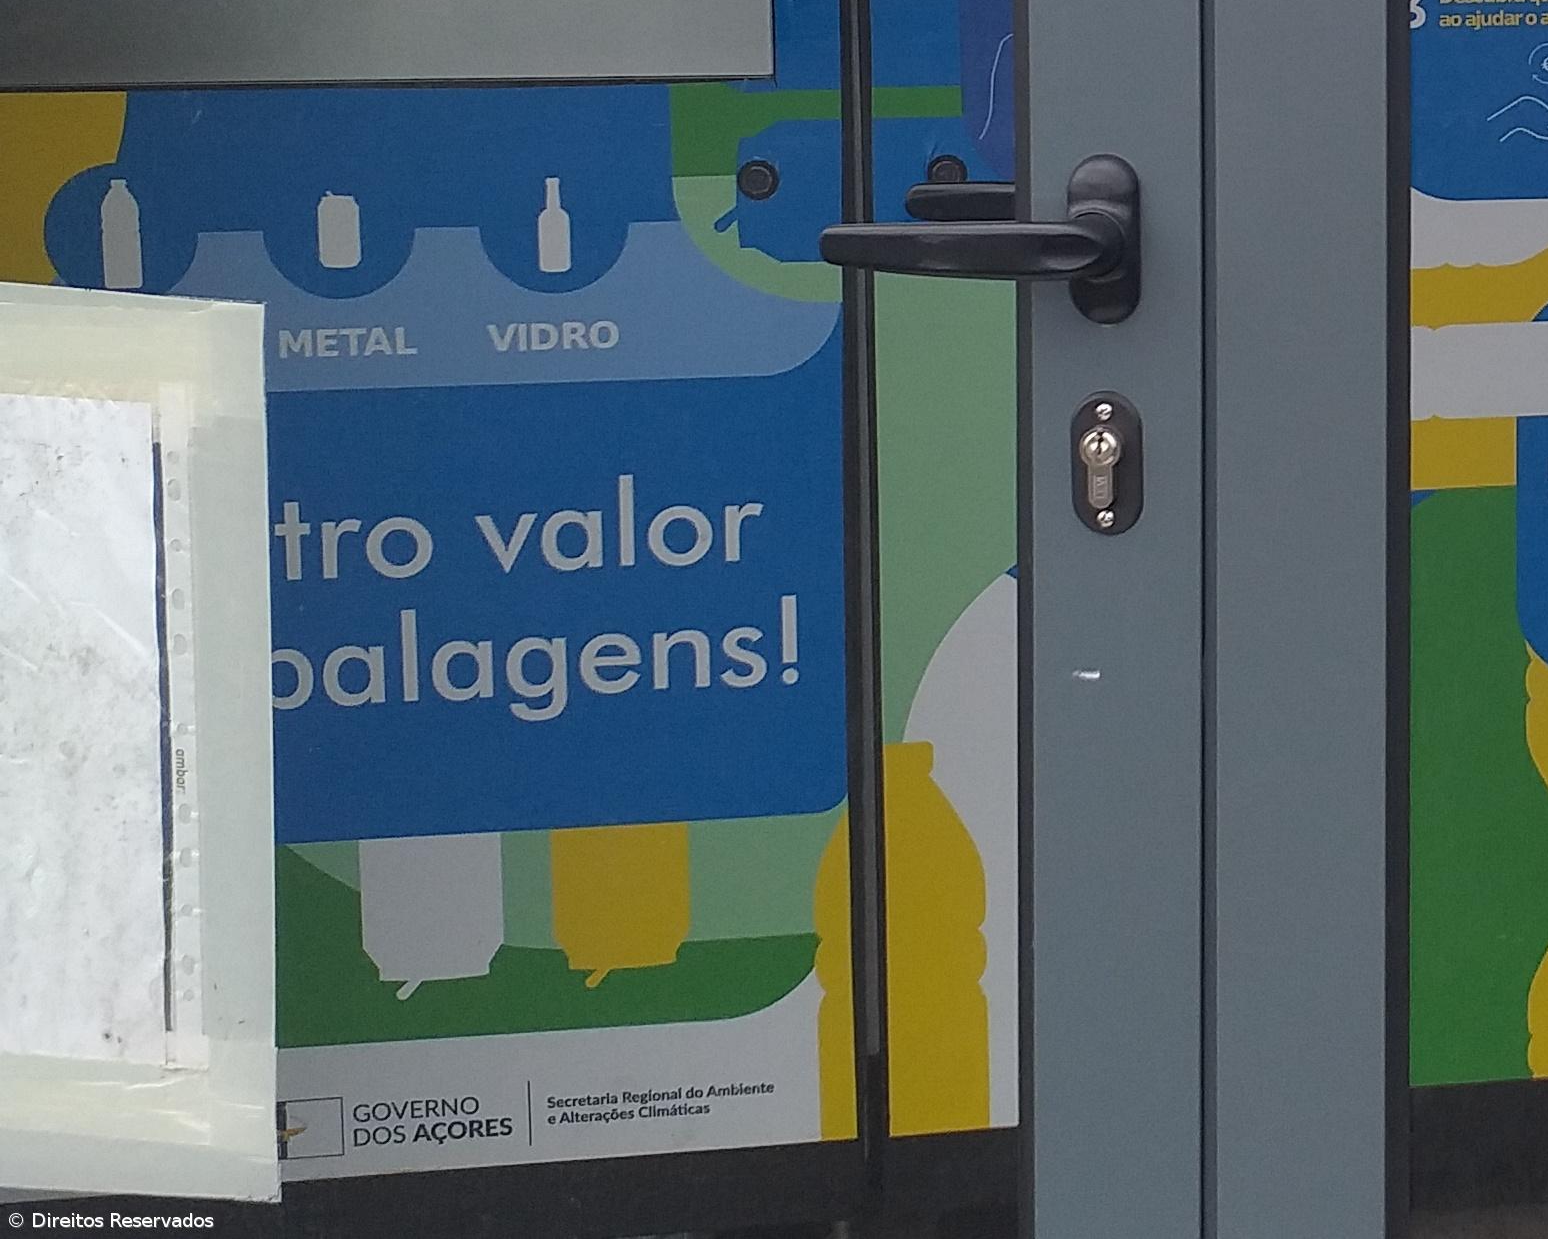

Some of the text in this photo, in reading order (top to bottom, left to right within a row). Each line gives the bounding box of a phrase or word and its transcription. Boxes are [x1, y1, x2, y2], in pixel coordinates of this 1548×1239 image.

[1439, 14, 1463, 28] ao
[1465, 10, 1523, 30] ajudar
[1525, 13, 1537, 26] o
[278, 327, 418, 358] METAL
[486, 320, 620, 352] VIDRO
[274, 474, 764, 581] tro valor
[547, 1081, 775, 1109] Secretaria Regional do Ambiente
[353, 1097, 480, 1123] GOVERNO
[547, 1102, 711, 1124] e Alterações Climáticas
[353, 1117, 513, 1147] DOS AÇORES
